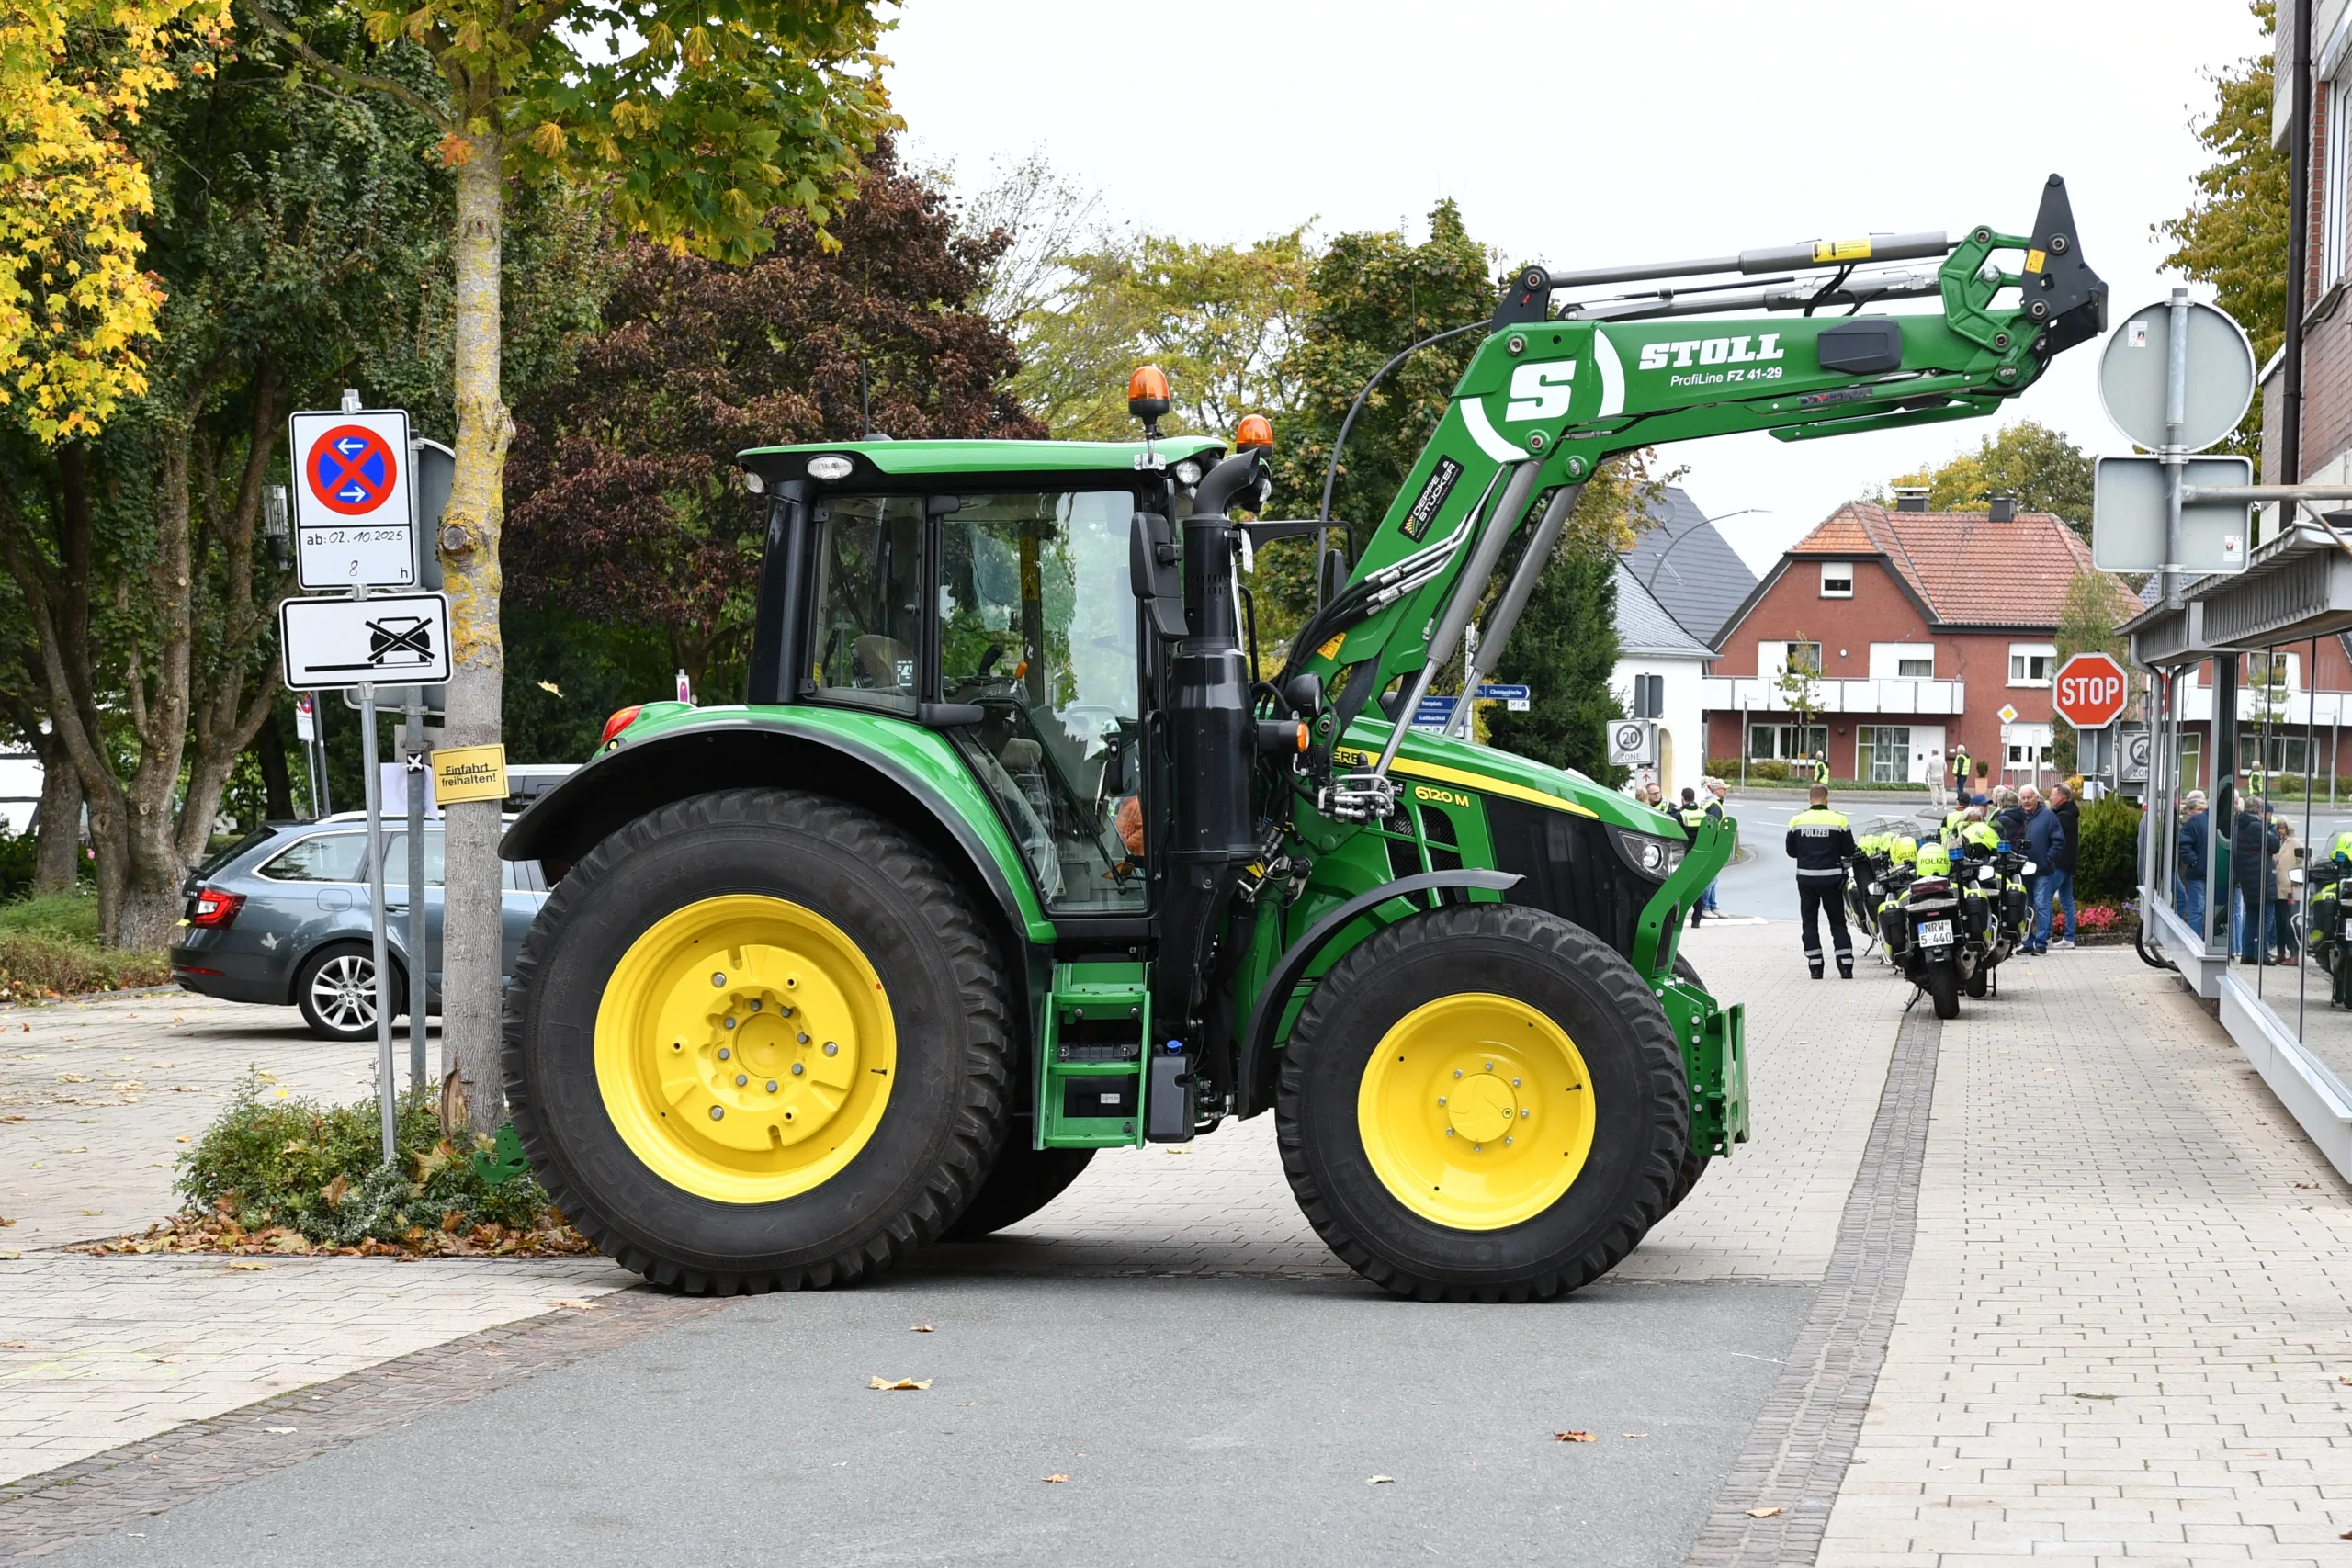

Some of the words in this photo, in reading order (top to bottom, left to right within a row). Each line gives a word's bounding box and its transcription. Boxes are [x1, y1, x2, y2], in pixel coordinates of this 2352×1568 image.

[1638, 333, 1784, 371] STOLL
[1670, 371, 1724, 388] ProfiLine
[1727, 369, 1744, 383] FZ
[1747, 367, 1782, 381] 41-29
[1505, 359, 1577, 423] S
[1413, 474, 1441, 516] DEPPE
[1419, 463, 1455, 522] STÜCKER
[349, 559, 359, 577] 8
[400, 567, 408, 579] h
[2061, 676, 2120, 705] STOP
[1622, 731, 1638, 745] 20
[1334, 750, 1359, 763] ERE
[1620, 752, 1642, 761] ZONE
[446, 762, 489, 775] Einfahrt
[441, 773, 496, 787] freihalten!
[1415, 785, 1453, 804] 6120
[1454, 793, 1470, 807] M
[1801, 829, 1829, 837] POLIZEI
[1920, 857, 1949, 865] POLIZE
[1925, 921, 1944, 933] NRW
